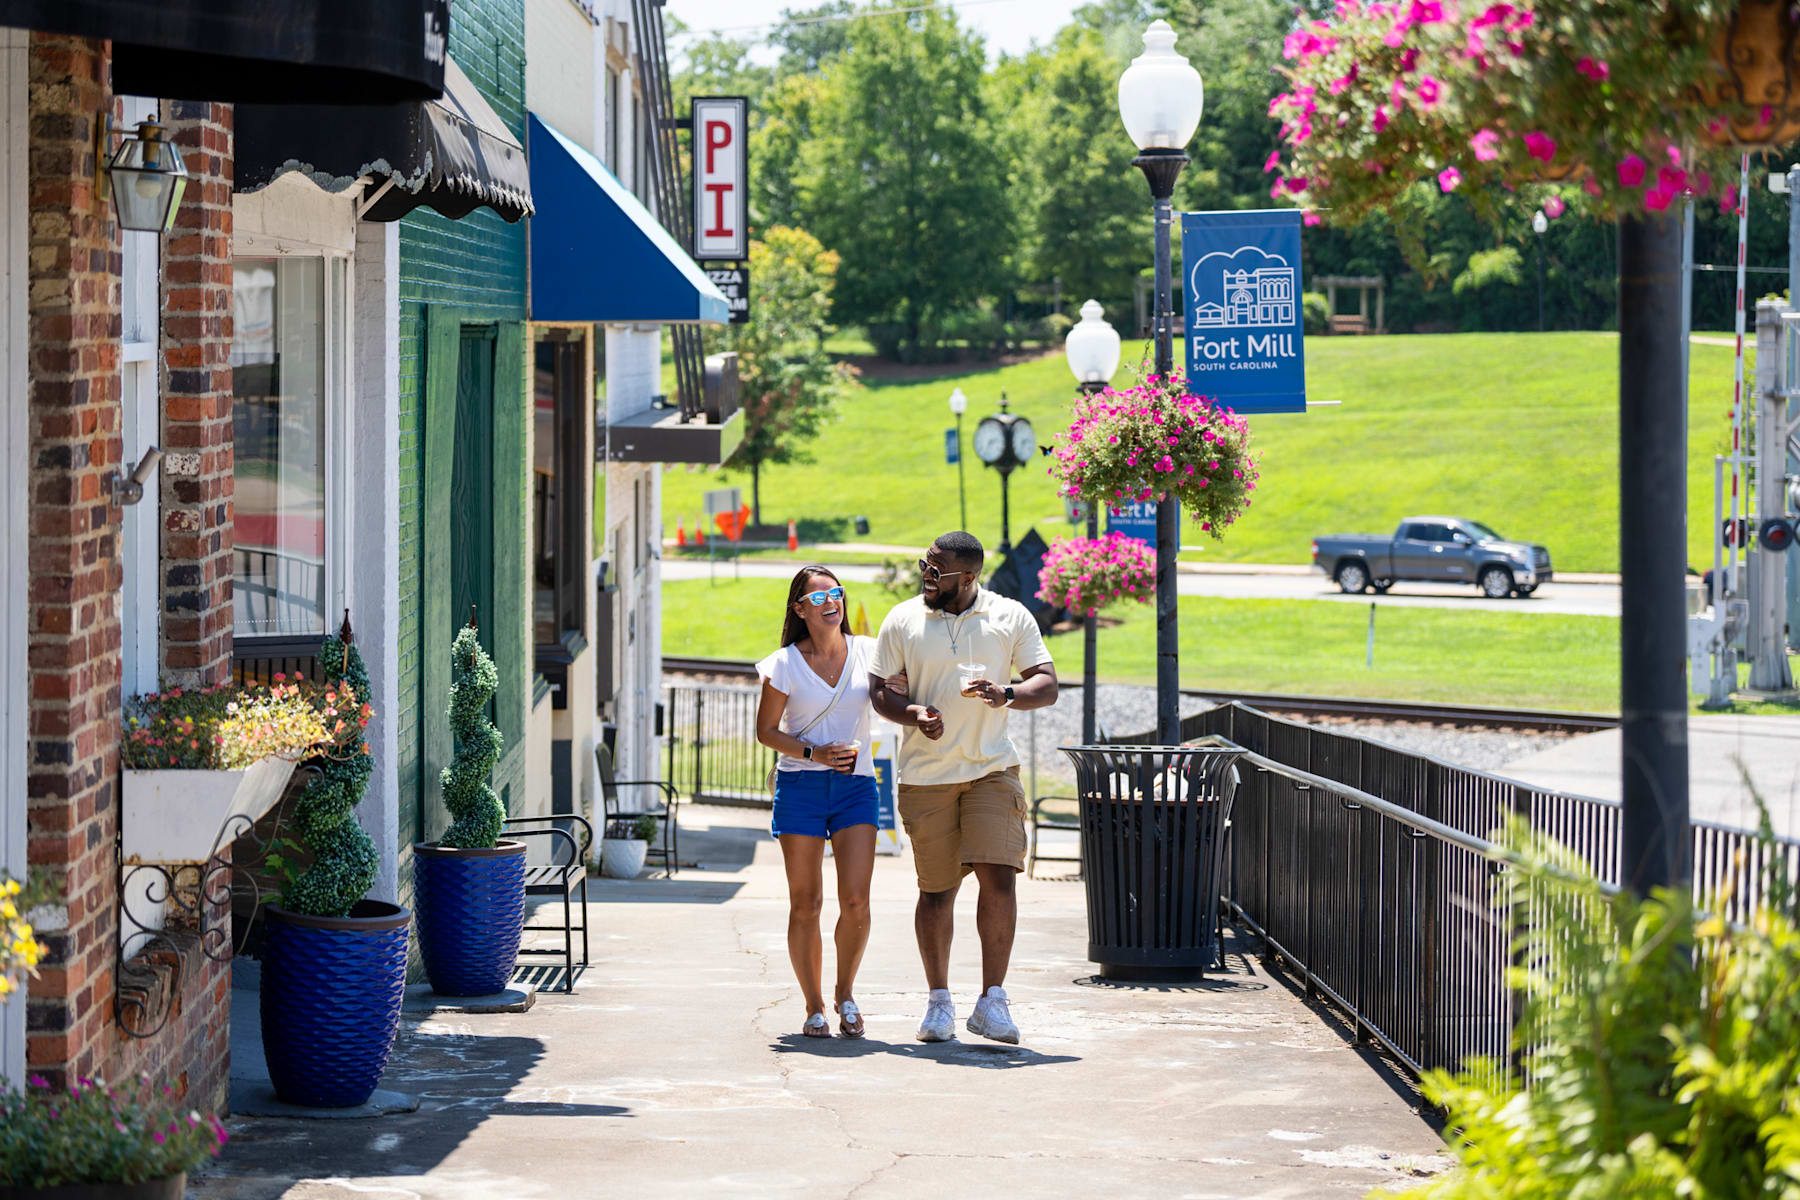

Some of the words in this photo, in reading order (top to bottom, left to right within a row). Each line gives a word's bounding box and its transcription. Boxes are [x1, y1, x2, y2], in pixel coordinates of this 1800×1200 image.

[705, 120, 734, 237] PI
[1193, 336, 1241, 360] Fort
[1247, 333, 1297, 358] Mill
[1193, 363, 1226, 372] SOUTH
[1229, 361, 1278, 370] CAROLINA
[1111, 503, 1142, 518] ort
